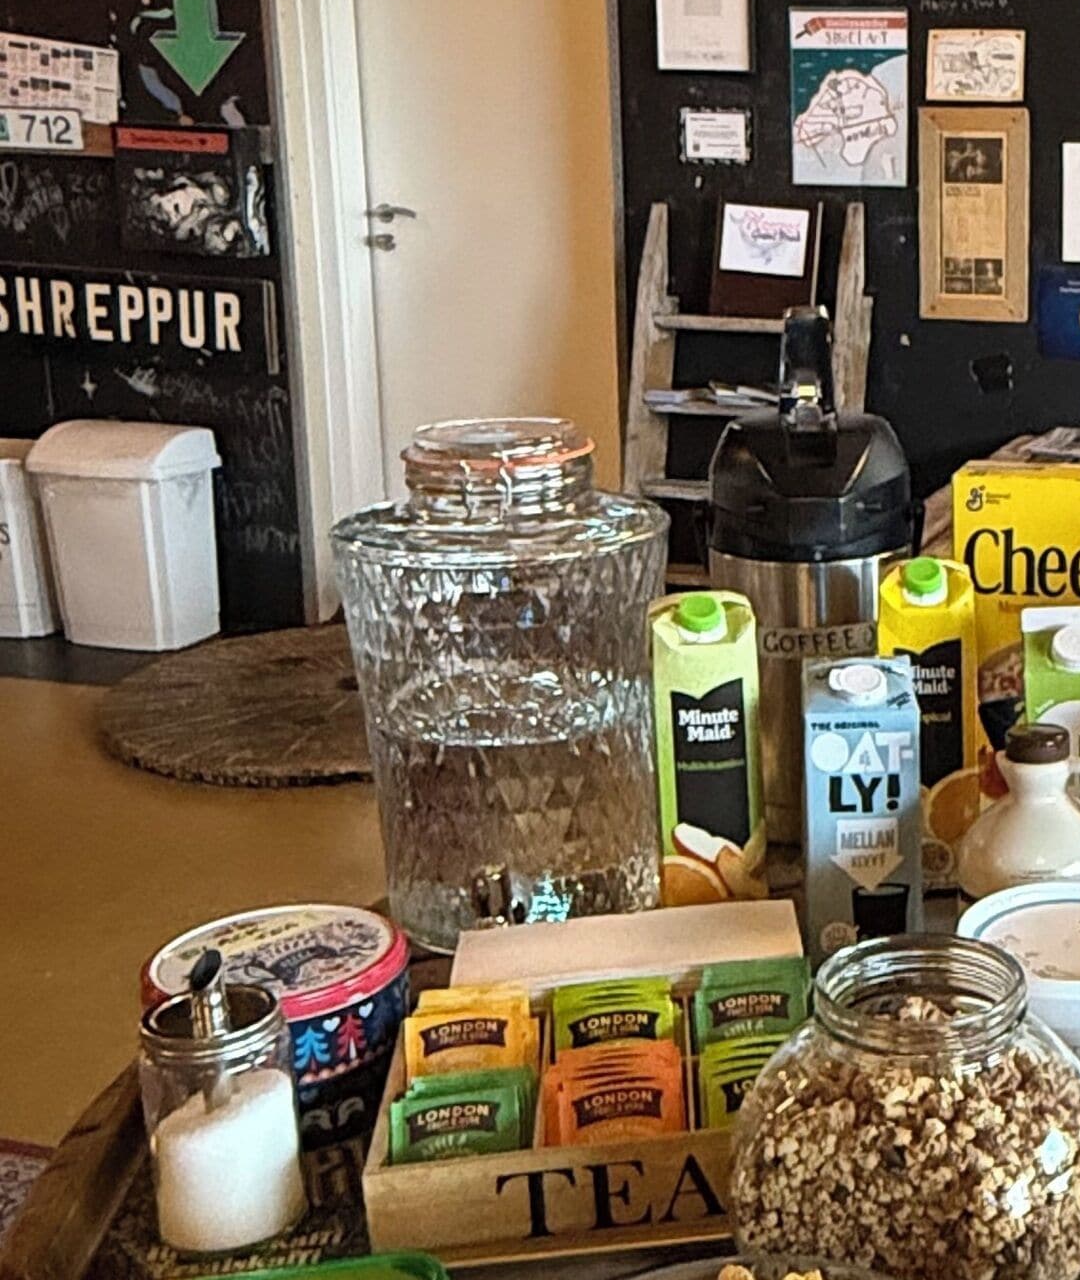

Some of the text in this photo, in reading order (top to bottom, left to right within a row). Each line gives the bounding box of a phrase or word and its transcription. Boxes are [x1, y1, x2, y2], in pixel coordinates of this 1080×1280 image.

[19, 114, 73, 145] 712
[763, 628, 857, 654] COFFEE
[678, 708, 739, 726] Minute
[687, 724, 732, 743] Maid
[829, 773, 901, 813] LY!
[718, 993, 782, 1011] LONDON
[430, 1020, 498, 1040] LONDON
[579, 1013, 649, 1033] LONDON
[584, 1089, 653, 1111] LONDON
[417, 1104, 490, 1125] LONDON
[495, 1153, 728, 1239] TEA
